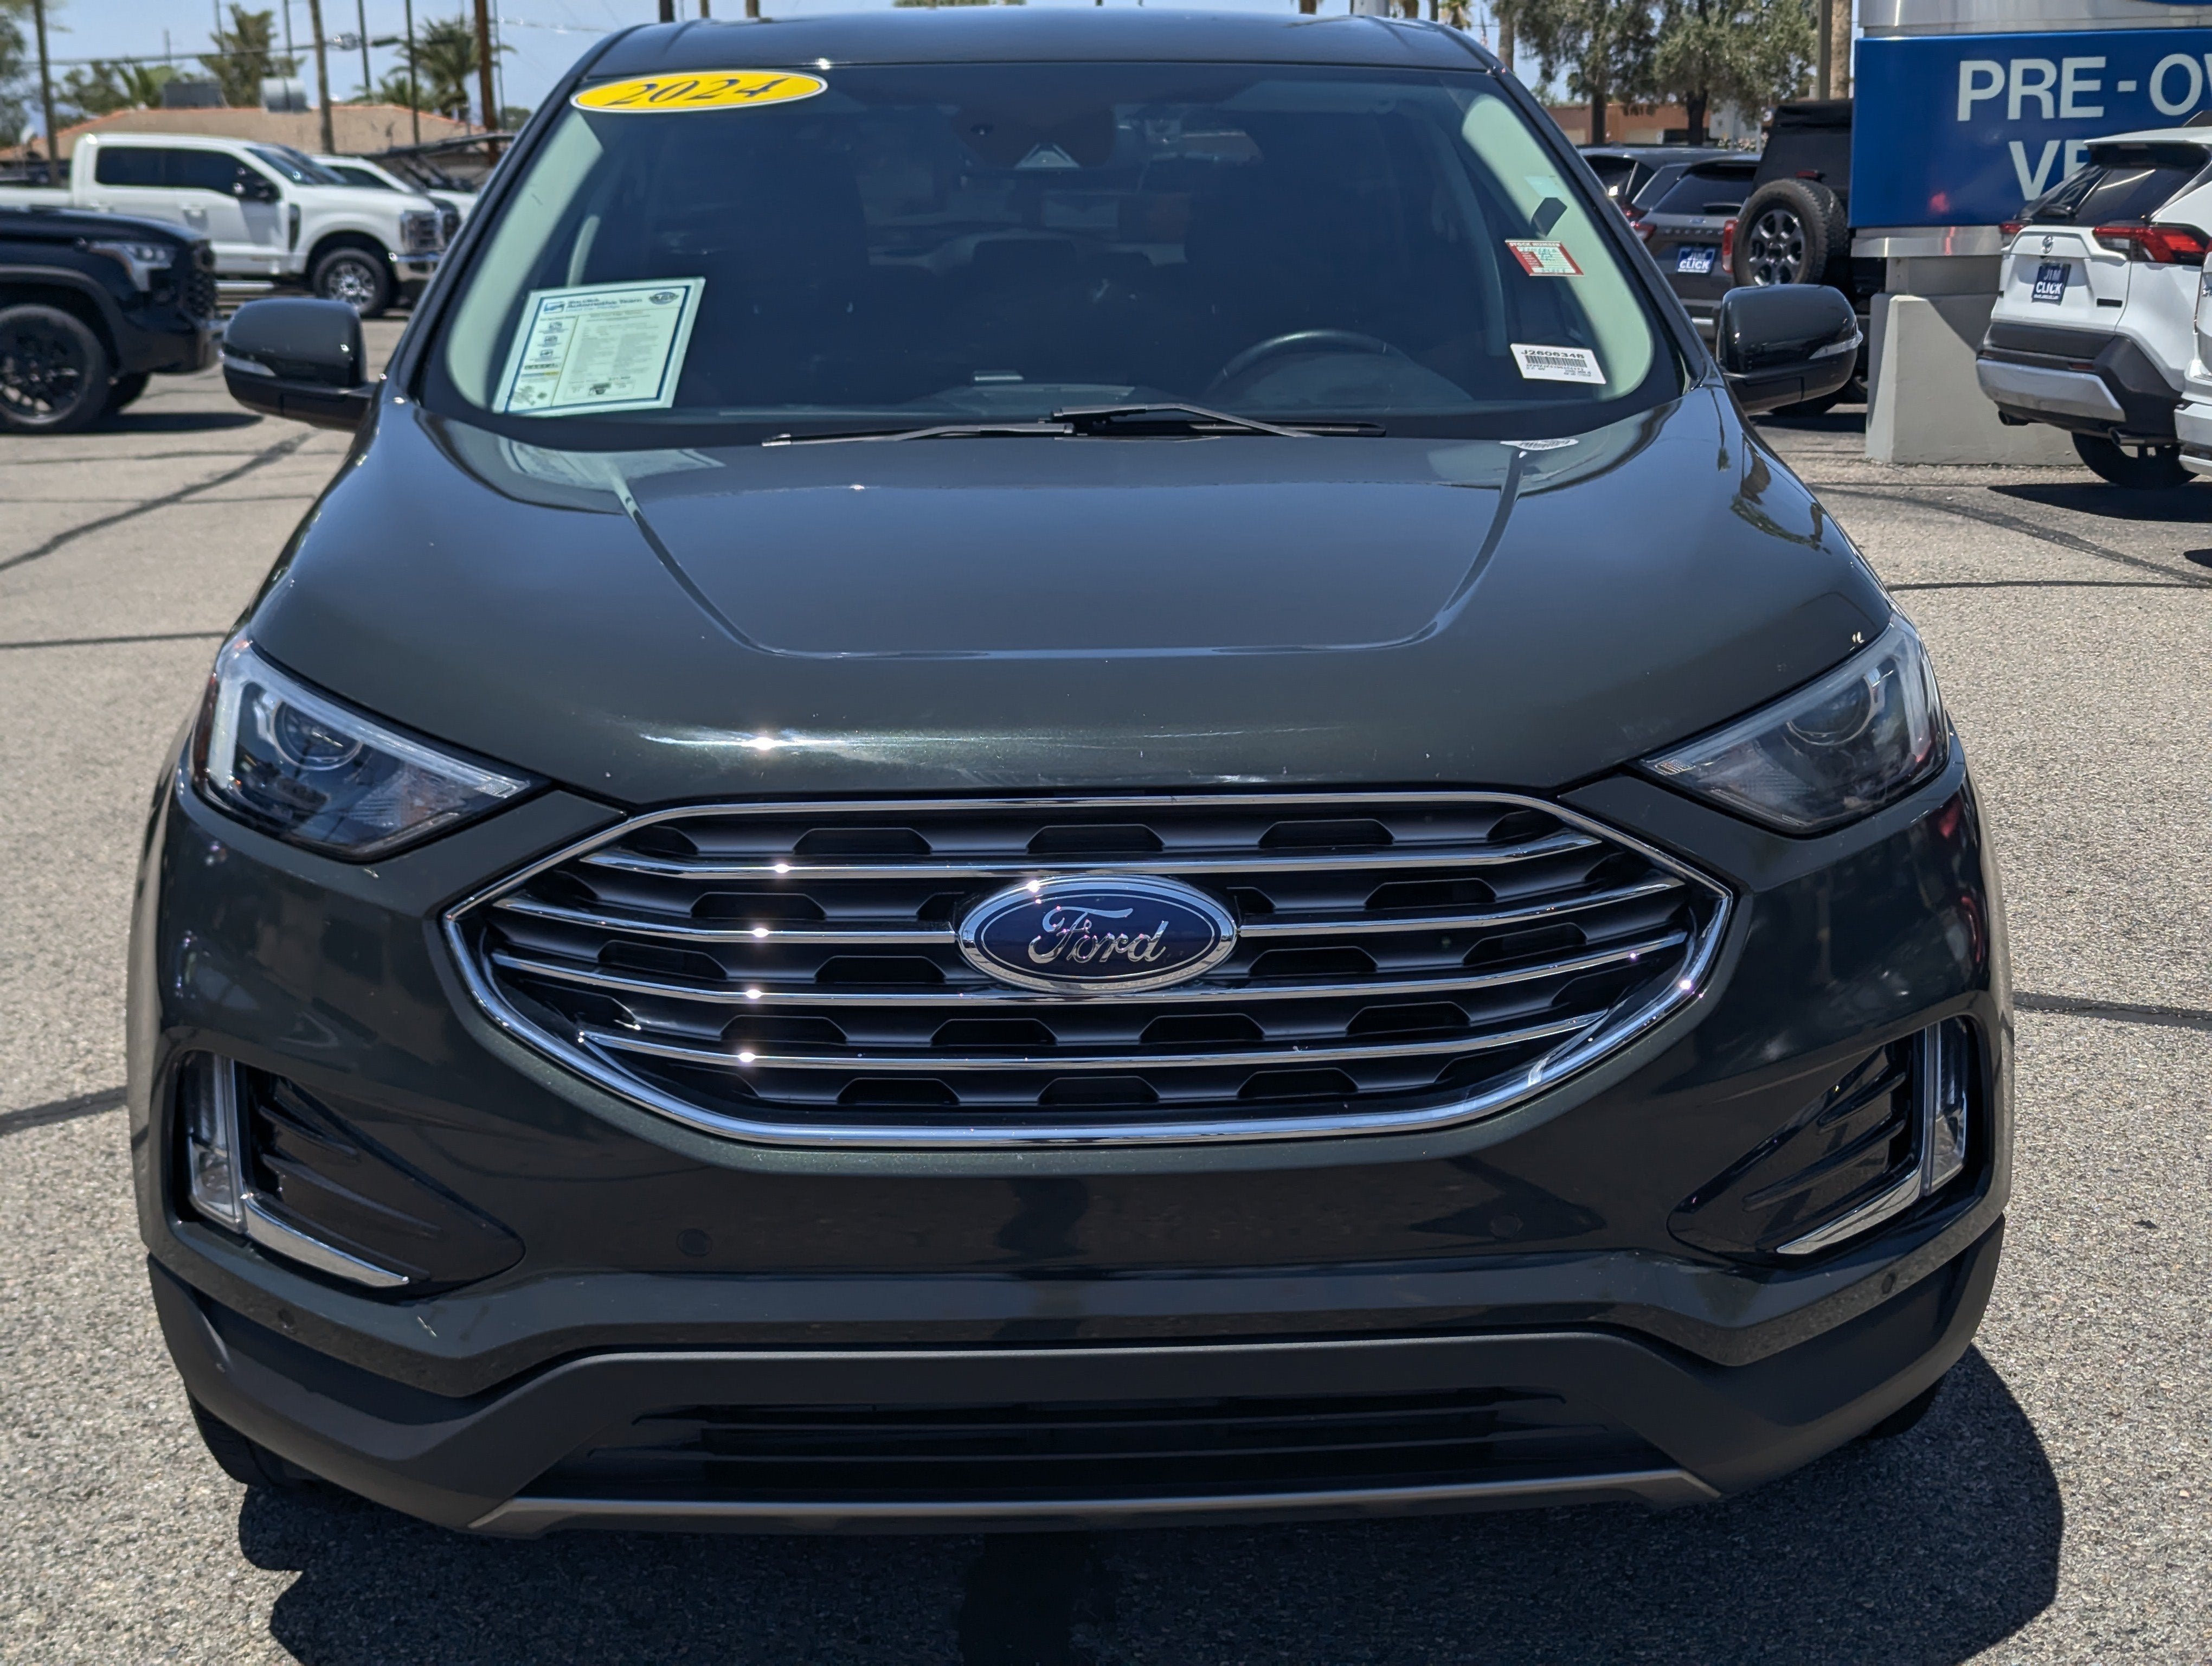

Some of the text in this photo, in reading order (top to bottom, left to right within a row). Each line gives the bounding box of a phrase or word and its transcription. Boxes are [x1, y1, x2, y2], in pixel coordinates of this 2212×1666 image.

[602, 78, 789, 106] 2024
[1957, 53, 2212, 121] PRE-O
[1679, 260, 1711, 270] CLICK
[2036, 281, 2063, 294] CLICK
[1028, 906, 1168, 964] Ford
